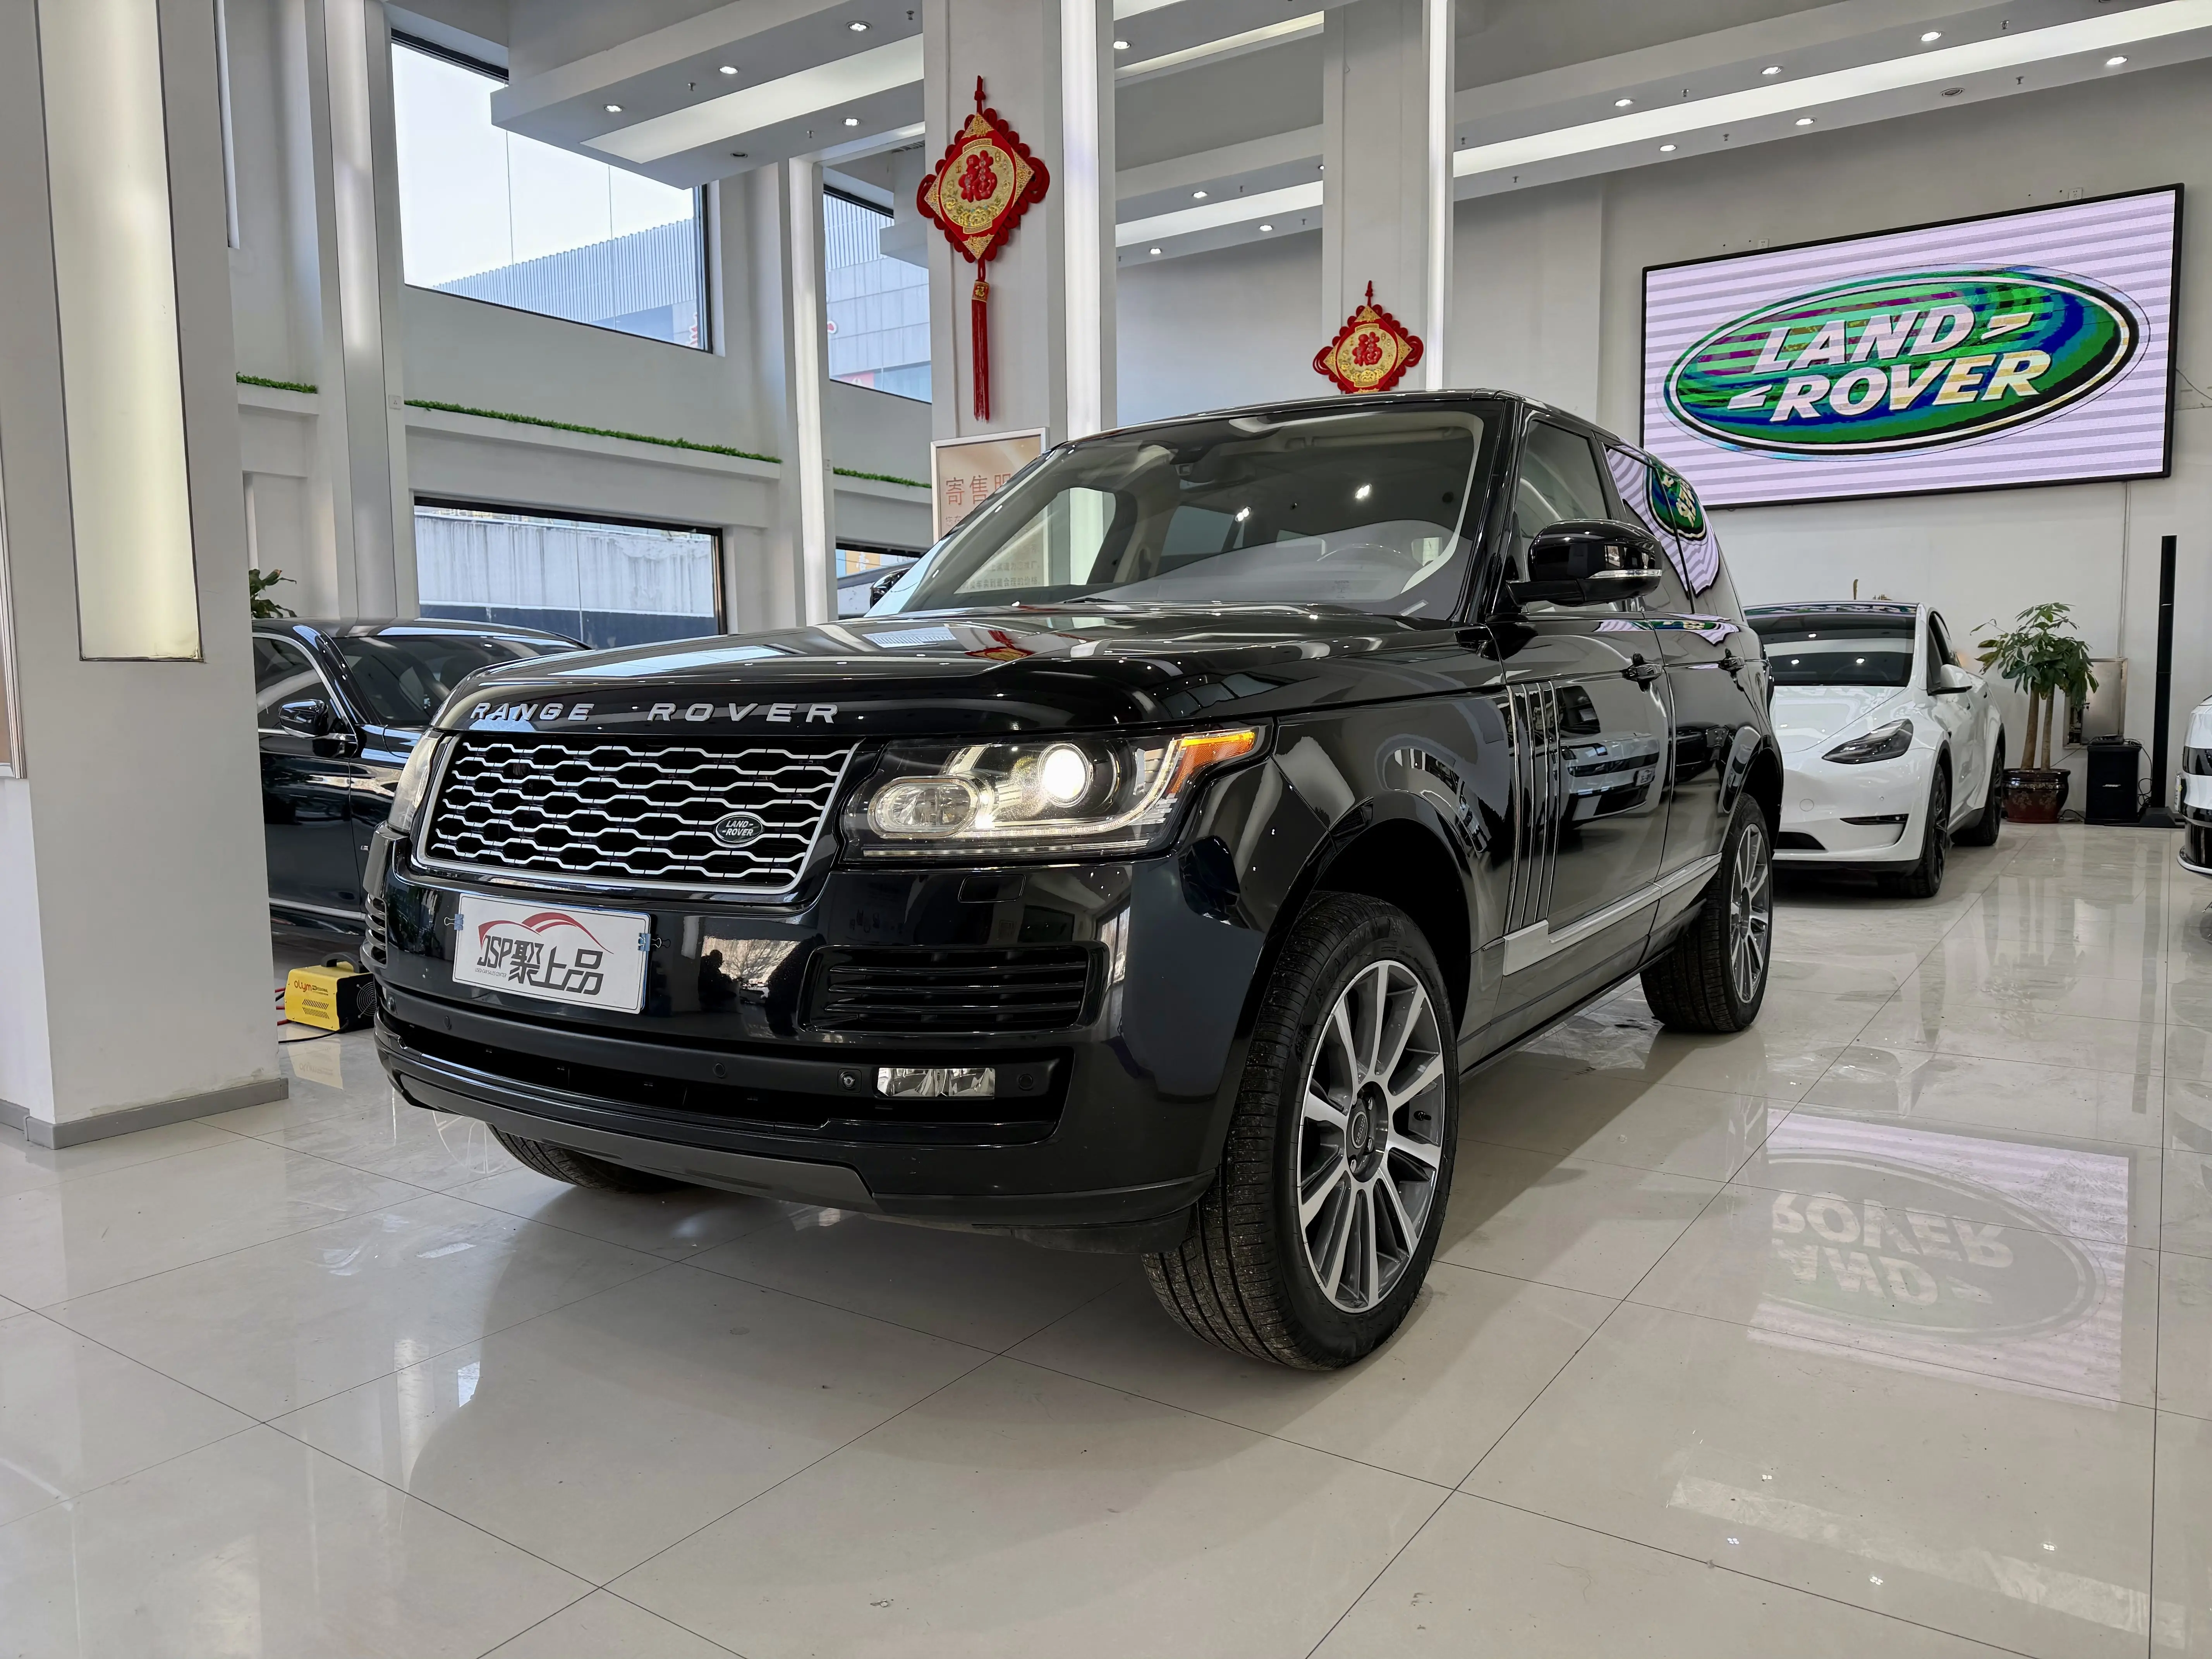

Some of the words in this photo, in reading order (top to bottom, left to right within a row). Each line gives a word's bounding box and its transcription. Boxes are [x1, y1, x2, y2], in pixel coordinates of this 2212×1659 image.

[958, 150, 997, 203] 福
[1352, 331, 1382, 367] 福
[1751, 304, 1975, 374] LAND
[1771, 350, 2052, 422] ROVER
[470, 702, 595, 721] RANGE
[647, 703, 838, 723] ROVER
